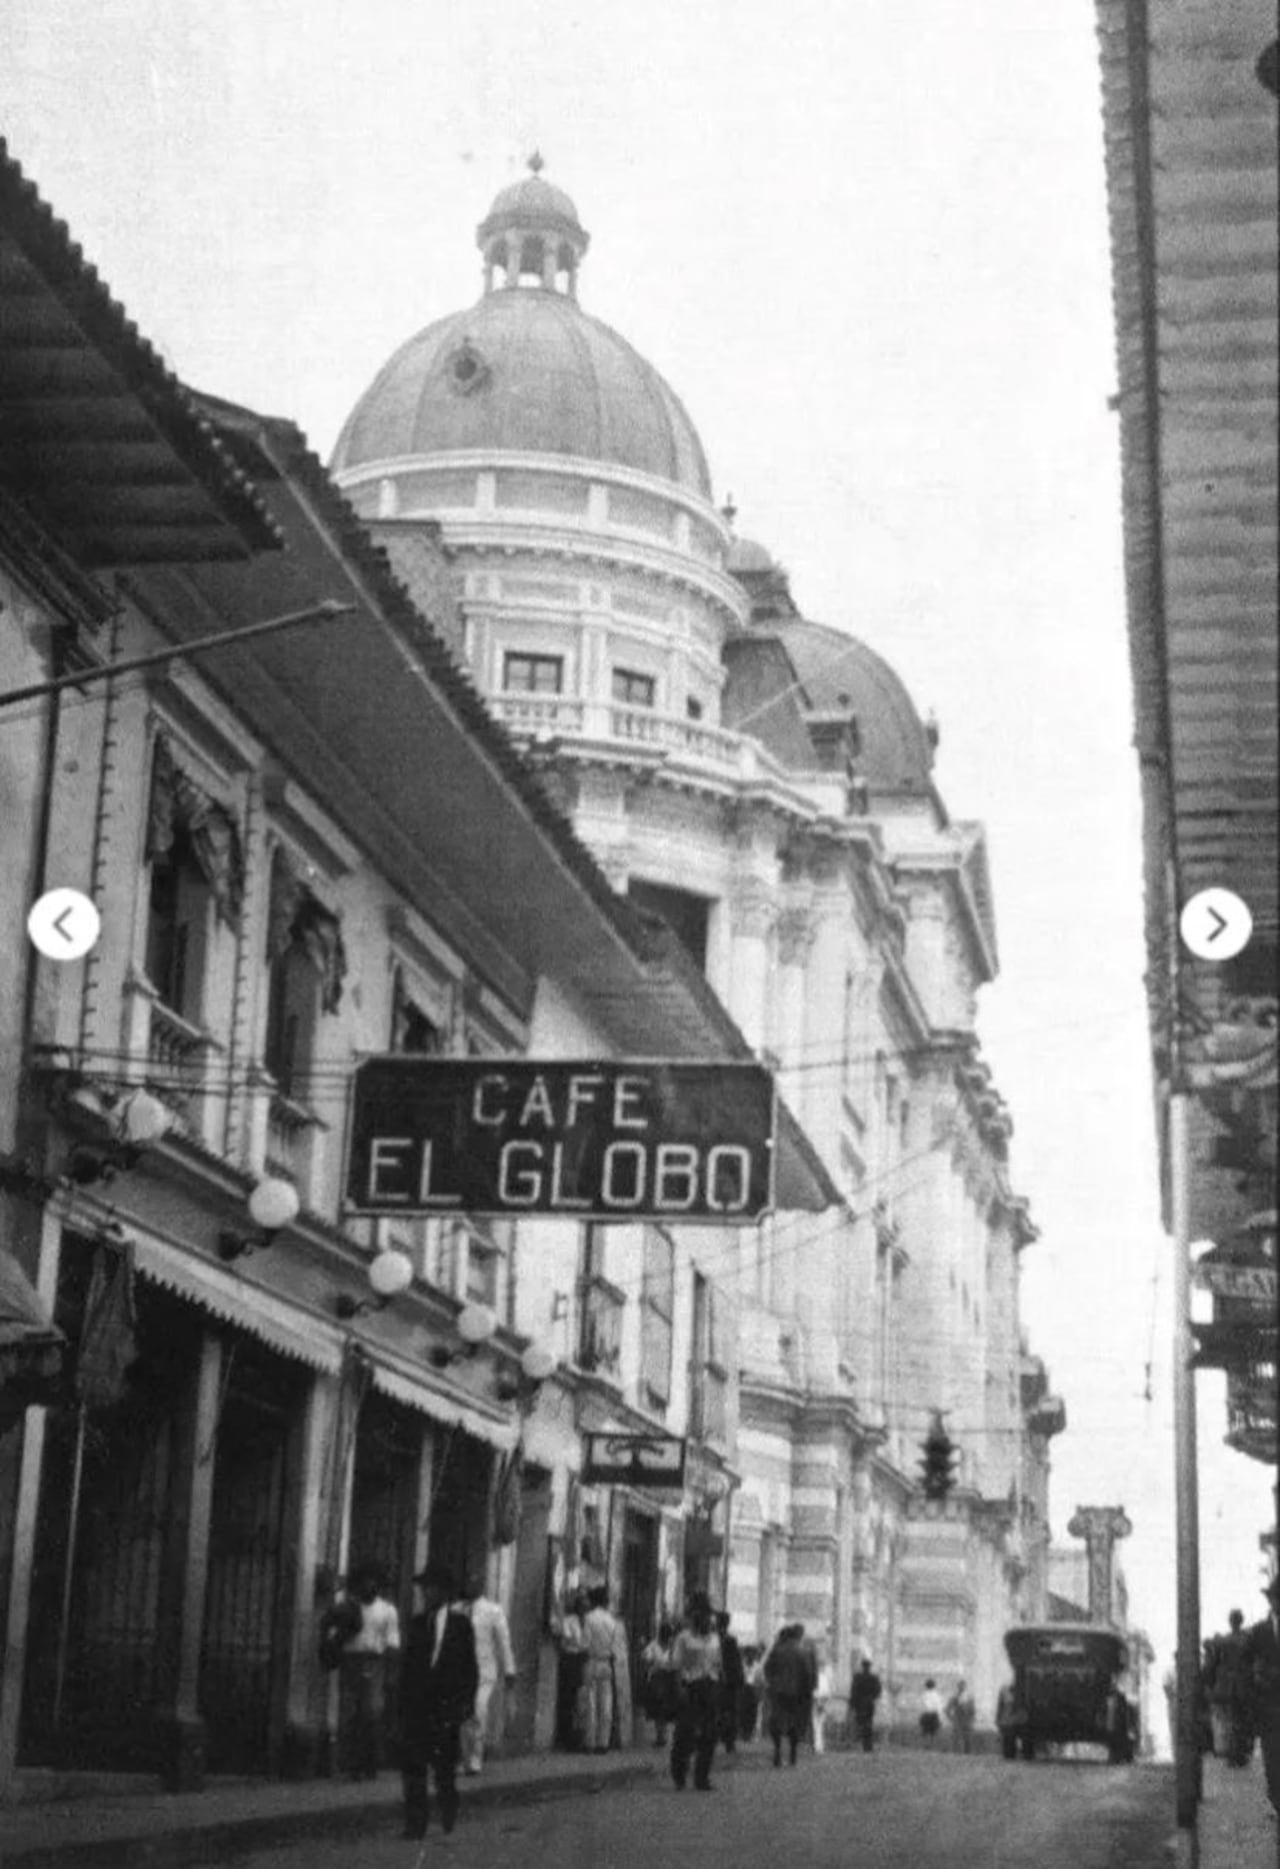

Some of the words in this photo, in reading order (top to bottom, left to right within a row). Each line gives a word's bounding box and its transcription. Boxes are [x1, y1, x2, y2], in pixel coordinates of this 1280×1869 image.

[472, 1075, 649, 1128] CAFE
[369, 1138, 462, 1204] EL
[499, 1140, 752, 1211] GLOBO
